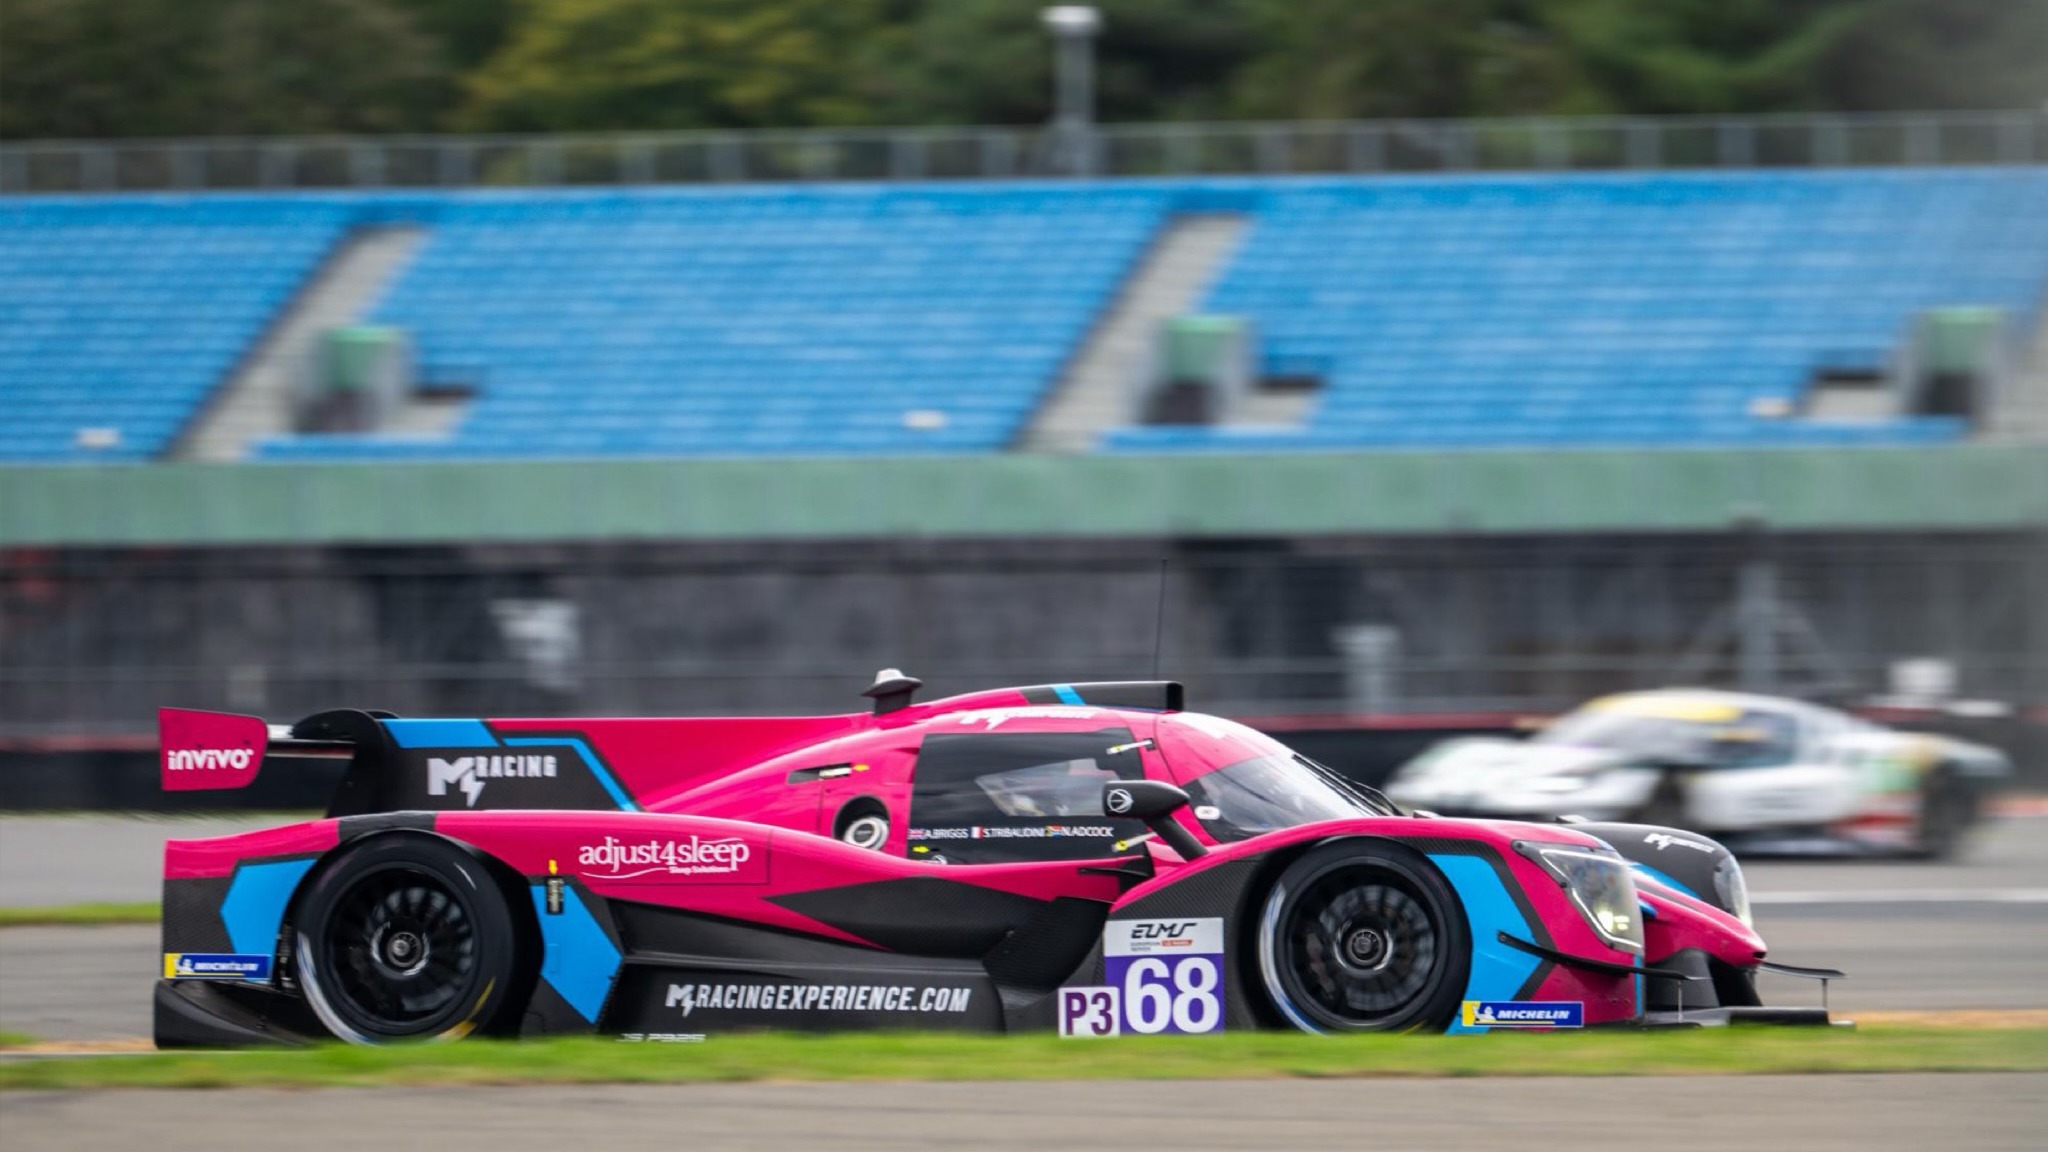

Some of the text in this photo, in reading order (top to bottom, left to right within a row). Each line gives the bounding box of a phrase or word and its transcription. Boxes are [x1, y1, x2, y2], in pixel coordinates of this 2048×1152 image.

[475, 755, 557, 778] RACING
[578, 835, 750, 873] adjust4sleep
[1065, 992, 1113, 1036] P3
[1125, 957, 1220, 1034] 68
[1497, 1010, 1570, 1020] MICHELIN
